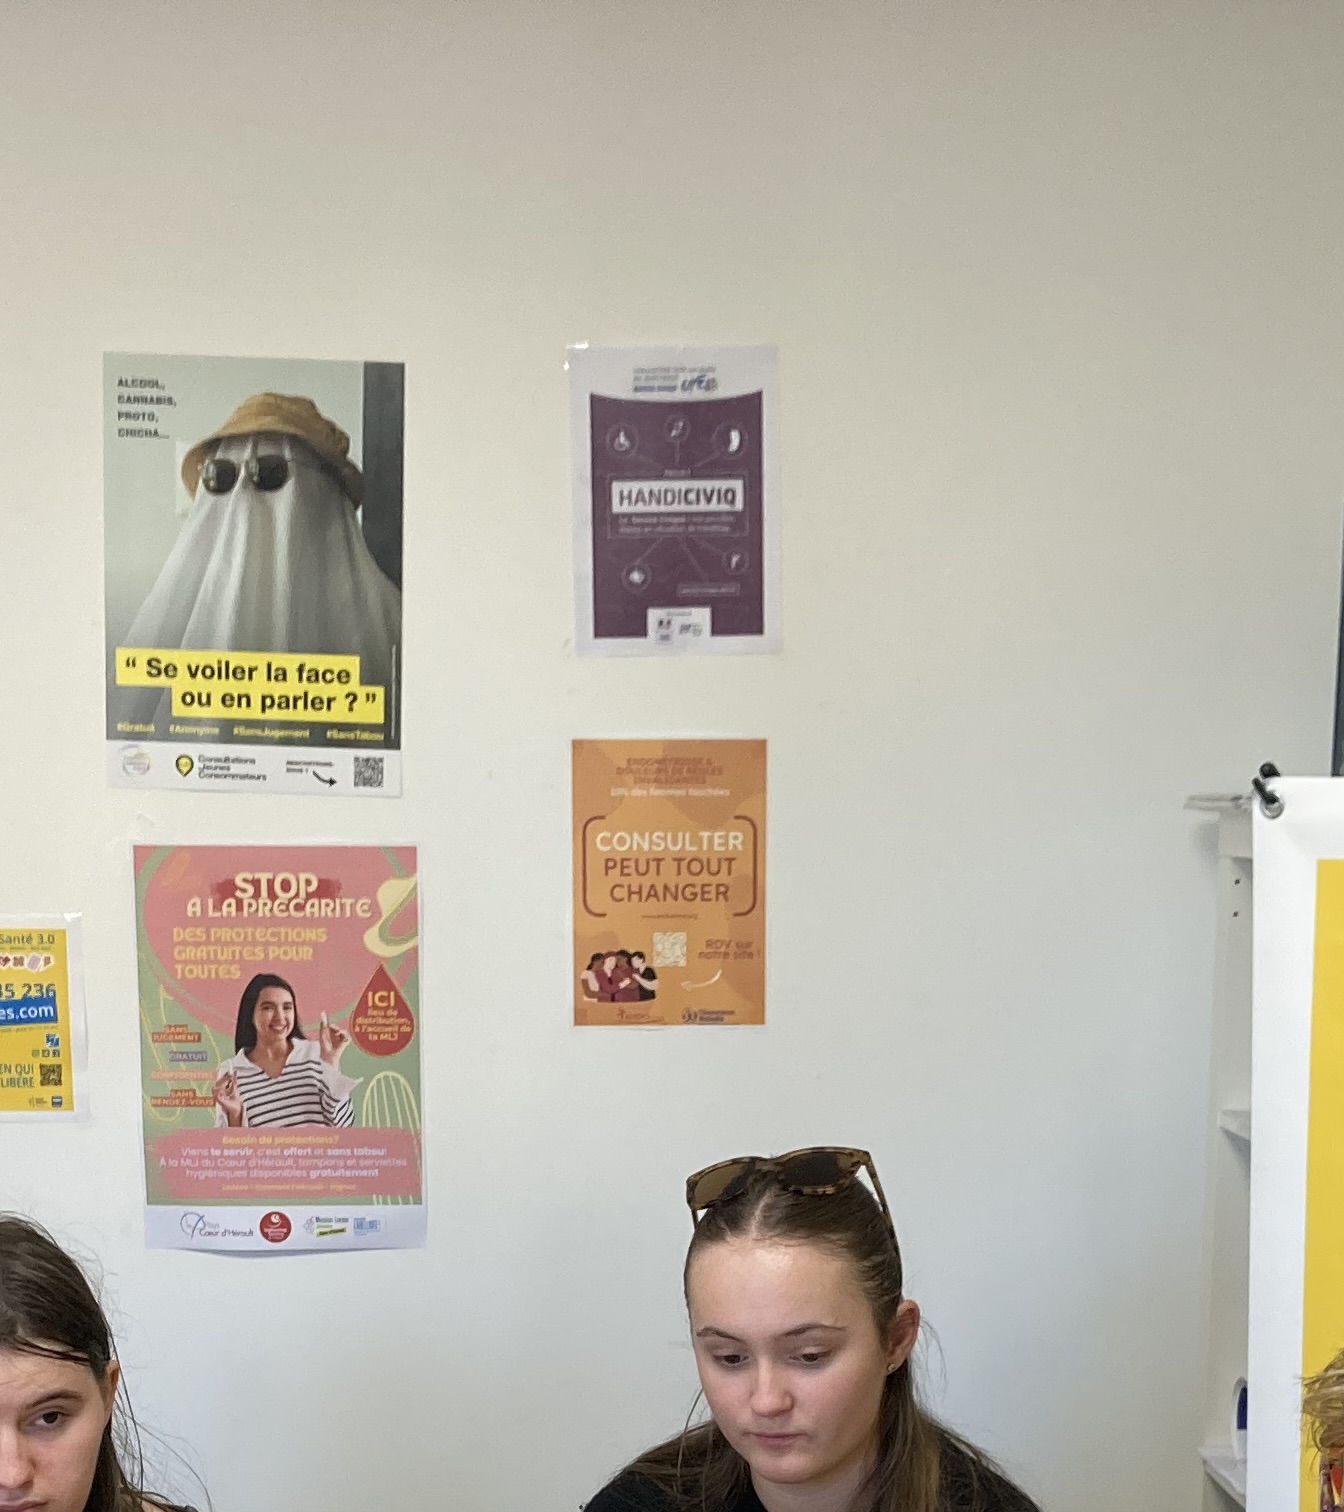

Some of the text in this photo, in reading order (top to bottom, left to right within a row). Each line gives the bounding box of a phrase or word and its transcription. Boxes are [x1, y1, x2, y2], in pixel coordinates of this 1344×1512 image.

[618, 486, 737, 508] HANDICIVIQ
[146, 657, 352, 685] Se voiler la face
[180, 690, 358, 714] ou en parler ?
[595, 831, 745, 852] CONSULTER
[603, 857, 738, 877] PEUT TOUT
[234, 871, 319, 899] STOP
[609, 883, 731, 903] CHANGER
[207, 897, 237, 918] LA
[36, 933, 56, 946] 3.0
[173, 926, 328, 943] DES PROTECTIONS
[173, 945, 313, 961] GRATUITES POUR
[174, 963, 241, 980] TOUTES
[21, 983, 56, 1000] 236
[367, 990, 396, 1008] ICI
